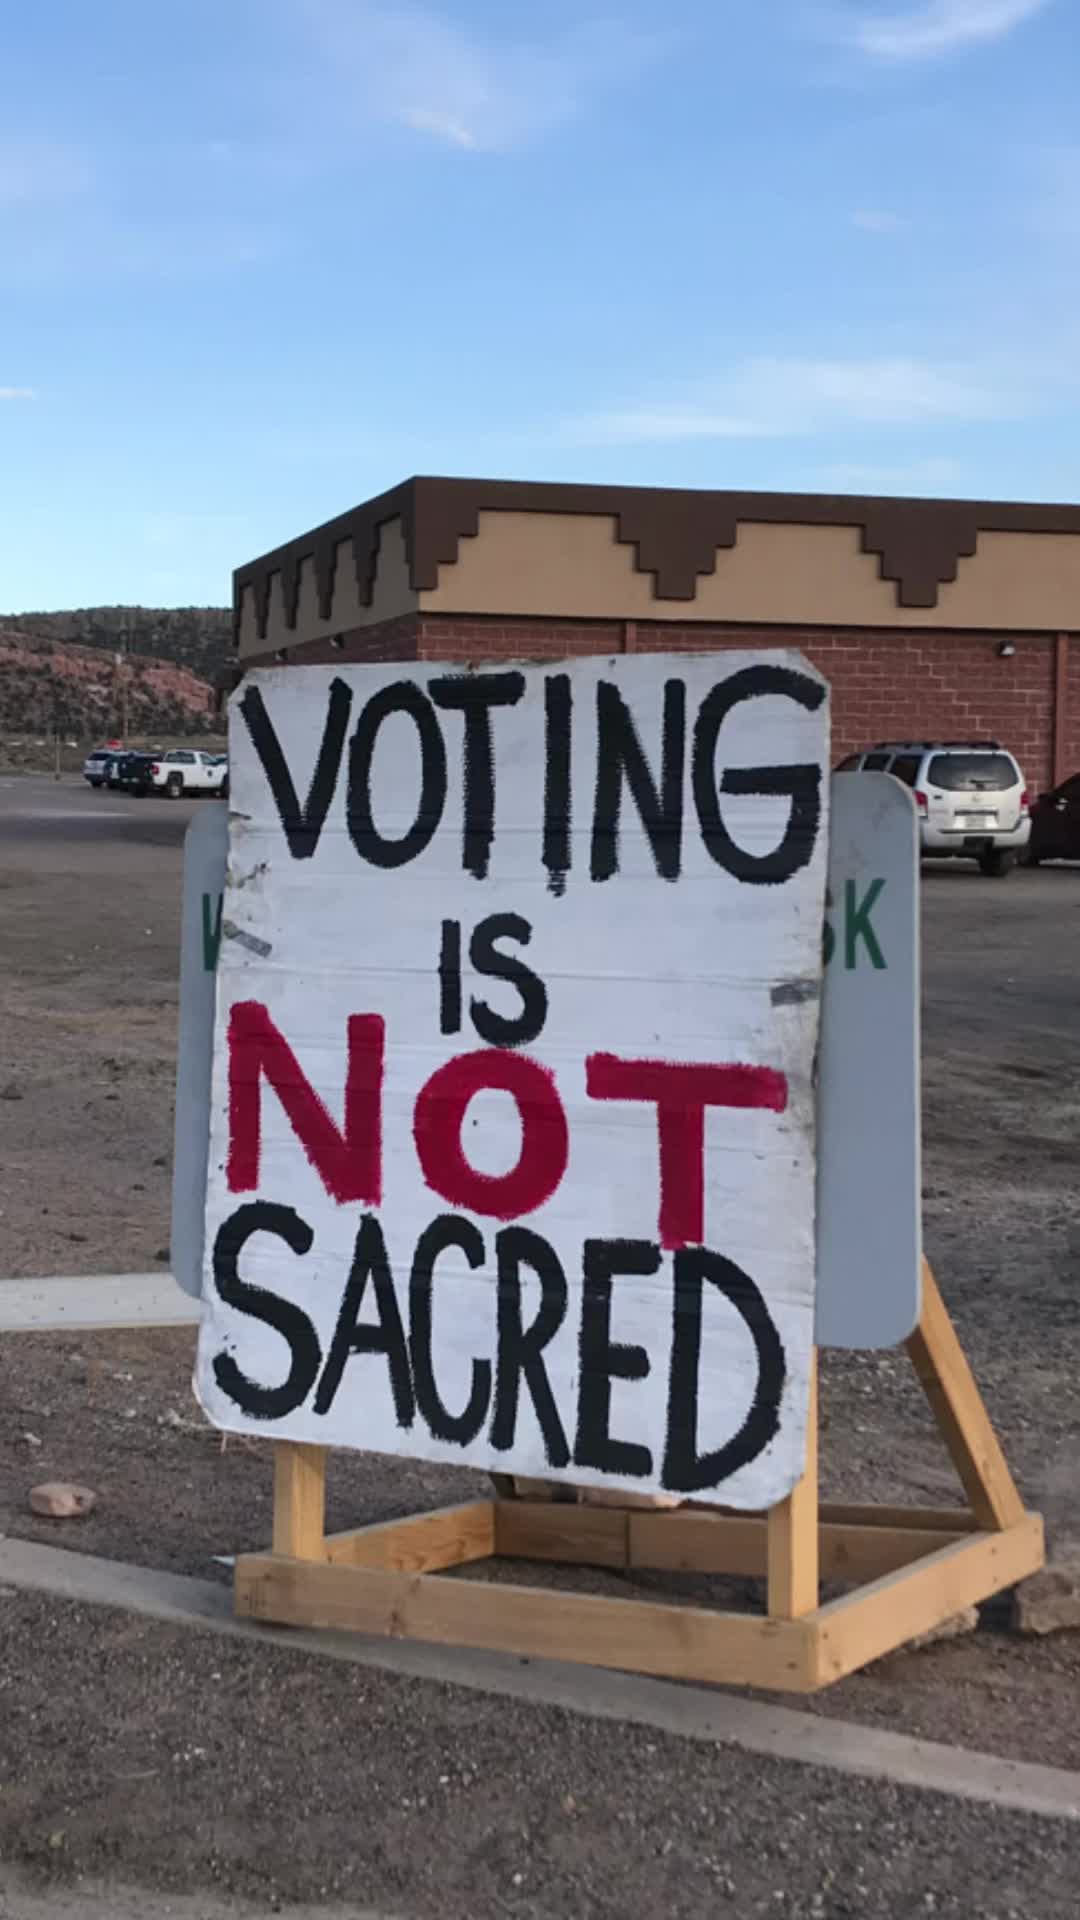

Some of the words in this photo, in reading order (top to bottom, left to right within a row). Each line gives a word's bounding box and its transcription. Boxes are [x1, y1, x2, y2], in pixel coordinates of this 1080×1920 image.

[238, 664, 827, 895] VOTING
[438, 912, 548, 1047] IS
[822, 877, 888, 970] K
[227, 1001, 787, 1251] NOT
[212, 1200, 787, 1492] SACRED
